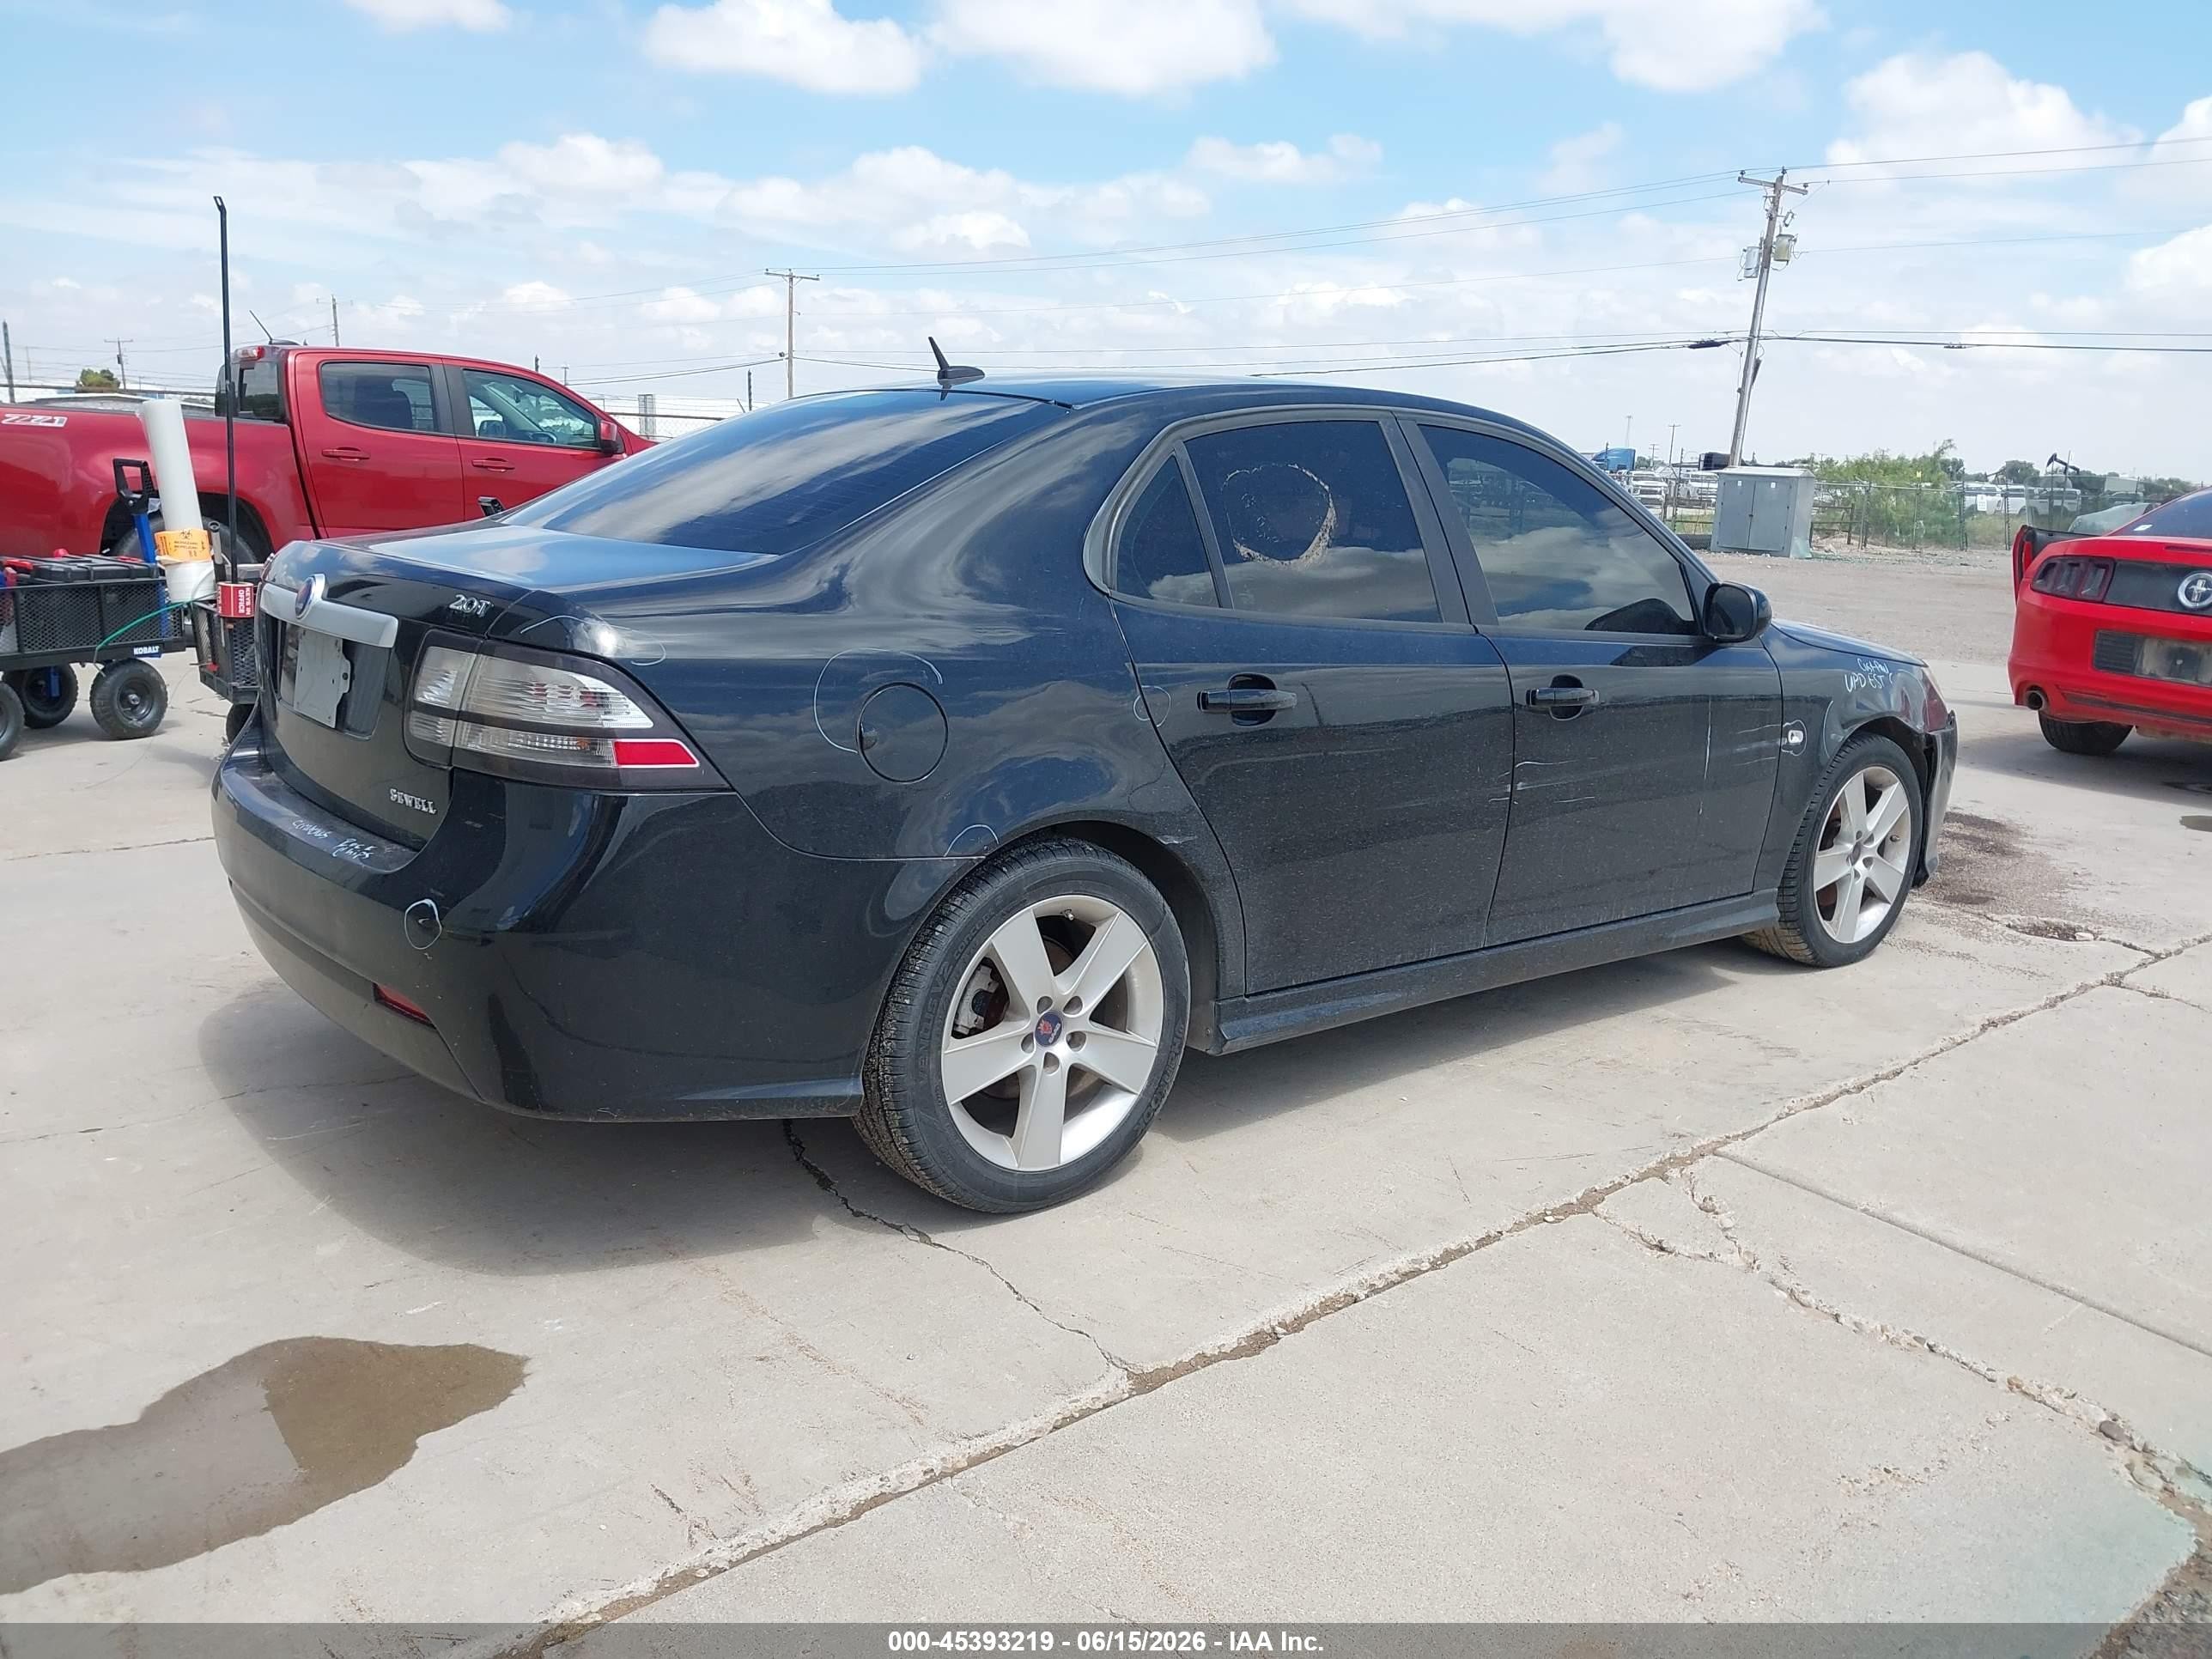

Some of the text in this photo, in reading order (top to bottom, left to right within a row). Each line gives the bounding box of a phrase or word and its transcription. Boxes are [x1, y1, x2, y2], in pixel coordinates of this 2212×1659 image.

[246, 607, 252, 616] IN
[133, 645, 160, 655] KOBALT
[389, 787, 437, 815] SEWELL
